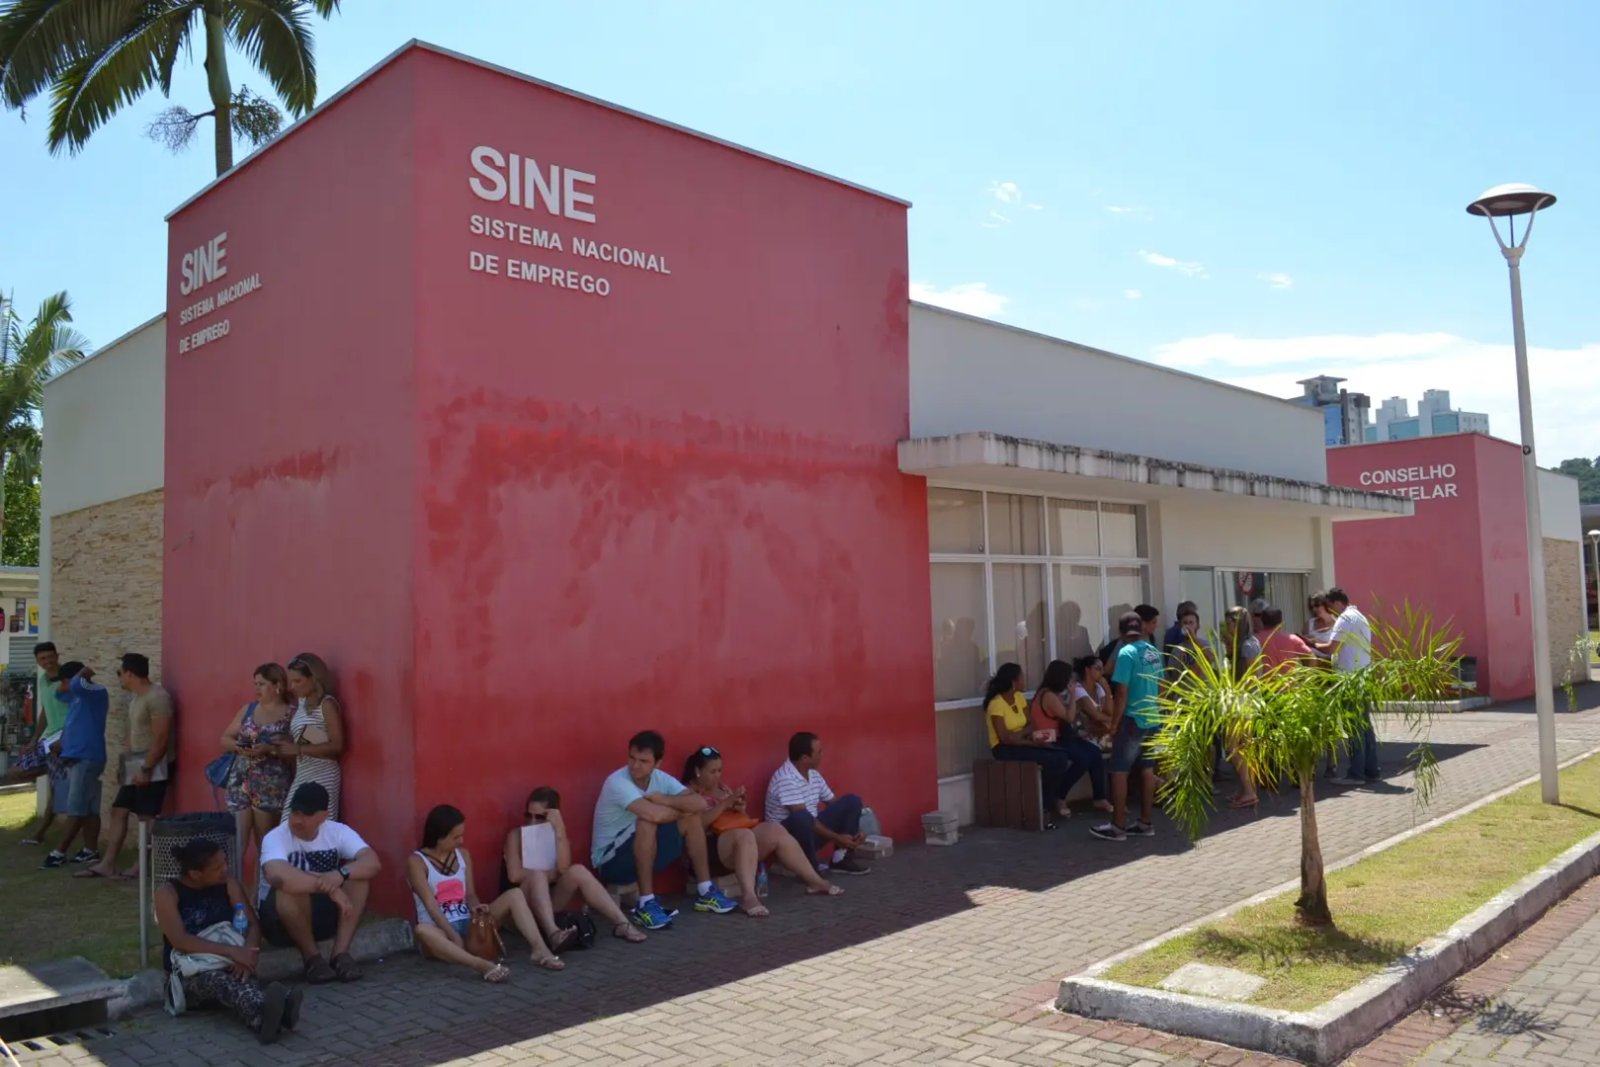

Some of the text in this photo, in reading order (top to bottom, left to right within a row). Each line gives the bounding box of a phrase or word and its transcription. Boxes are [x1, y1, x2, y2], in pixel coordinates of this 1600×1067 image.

[469, 146, 596, 223] SINE
[181, 232, 227, 295] SINE
[470, 215, 671, 274] SISTEMA NACIONAL
[469, 251, 610, 296] DE EMPREGO
[180, 273, 262, 325] SISTEMA NACIONAL
[180, 319, 229, 354] DE EMPREGO
[1360, 463, 1456, 486] CONSELHO
[1376, 483, 1458, 501] TELAR
